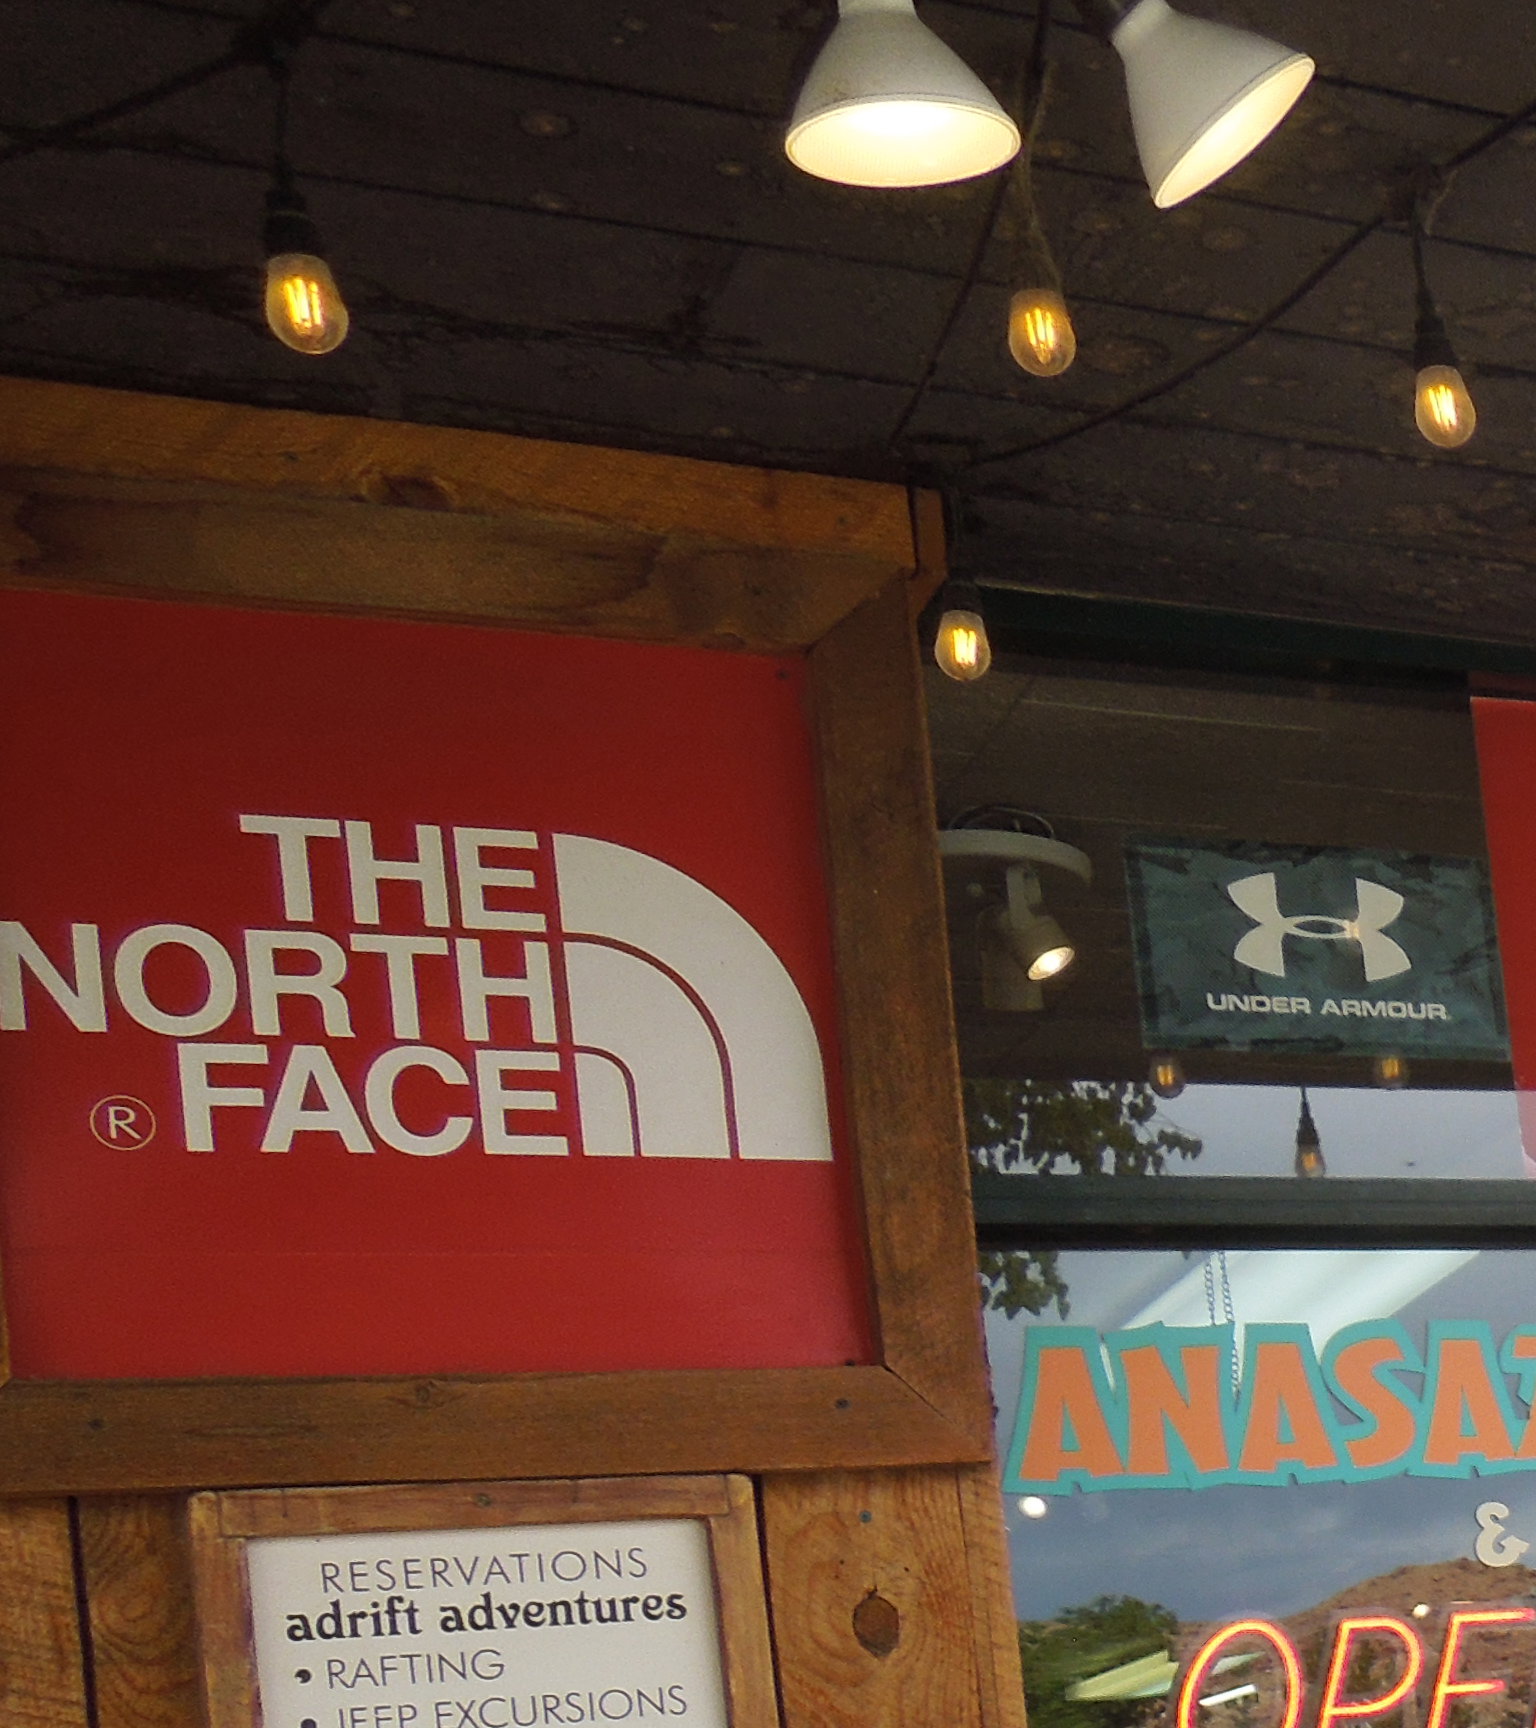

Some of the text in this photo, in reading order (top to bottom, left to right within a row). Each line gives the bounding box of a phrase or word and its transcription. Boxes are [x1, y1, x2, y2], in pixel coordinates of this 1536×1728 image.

[239, 813, 547, 932] THE
[0, 919, 558, 1043] NORTH
[1206, 991, 1452, 1022] UNDER ARMOUR
[178, 1042, 569, 1157] FACE
[1475, 1501, 1529, 1567] &
[320, 1547, 649, 1594] RESERVATIONS
[286, 1588, 688, 1642] adrift adventures
[326, 1649, 506, 1690] RAFTING
